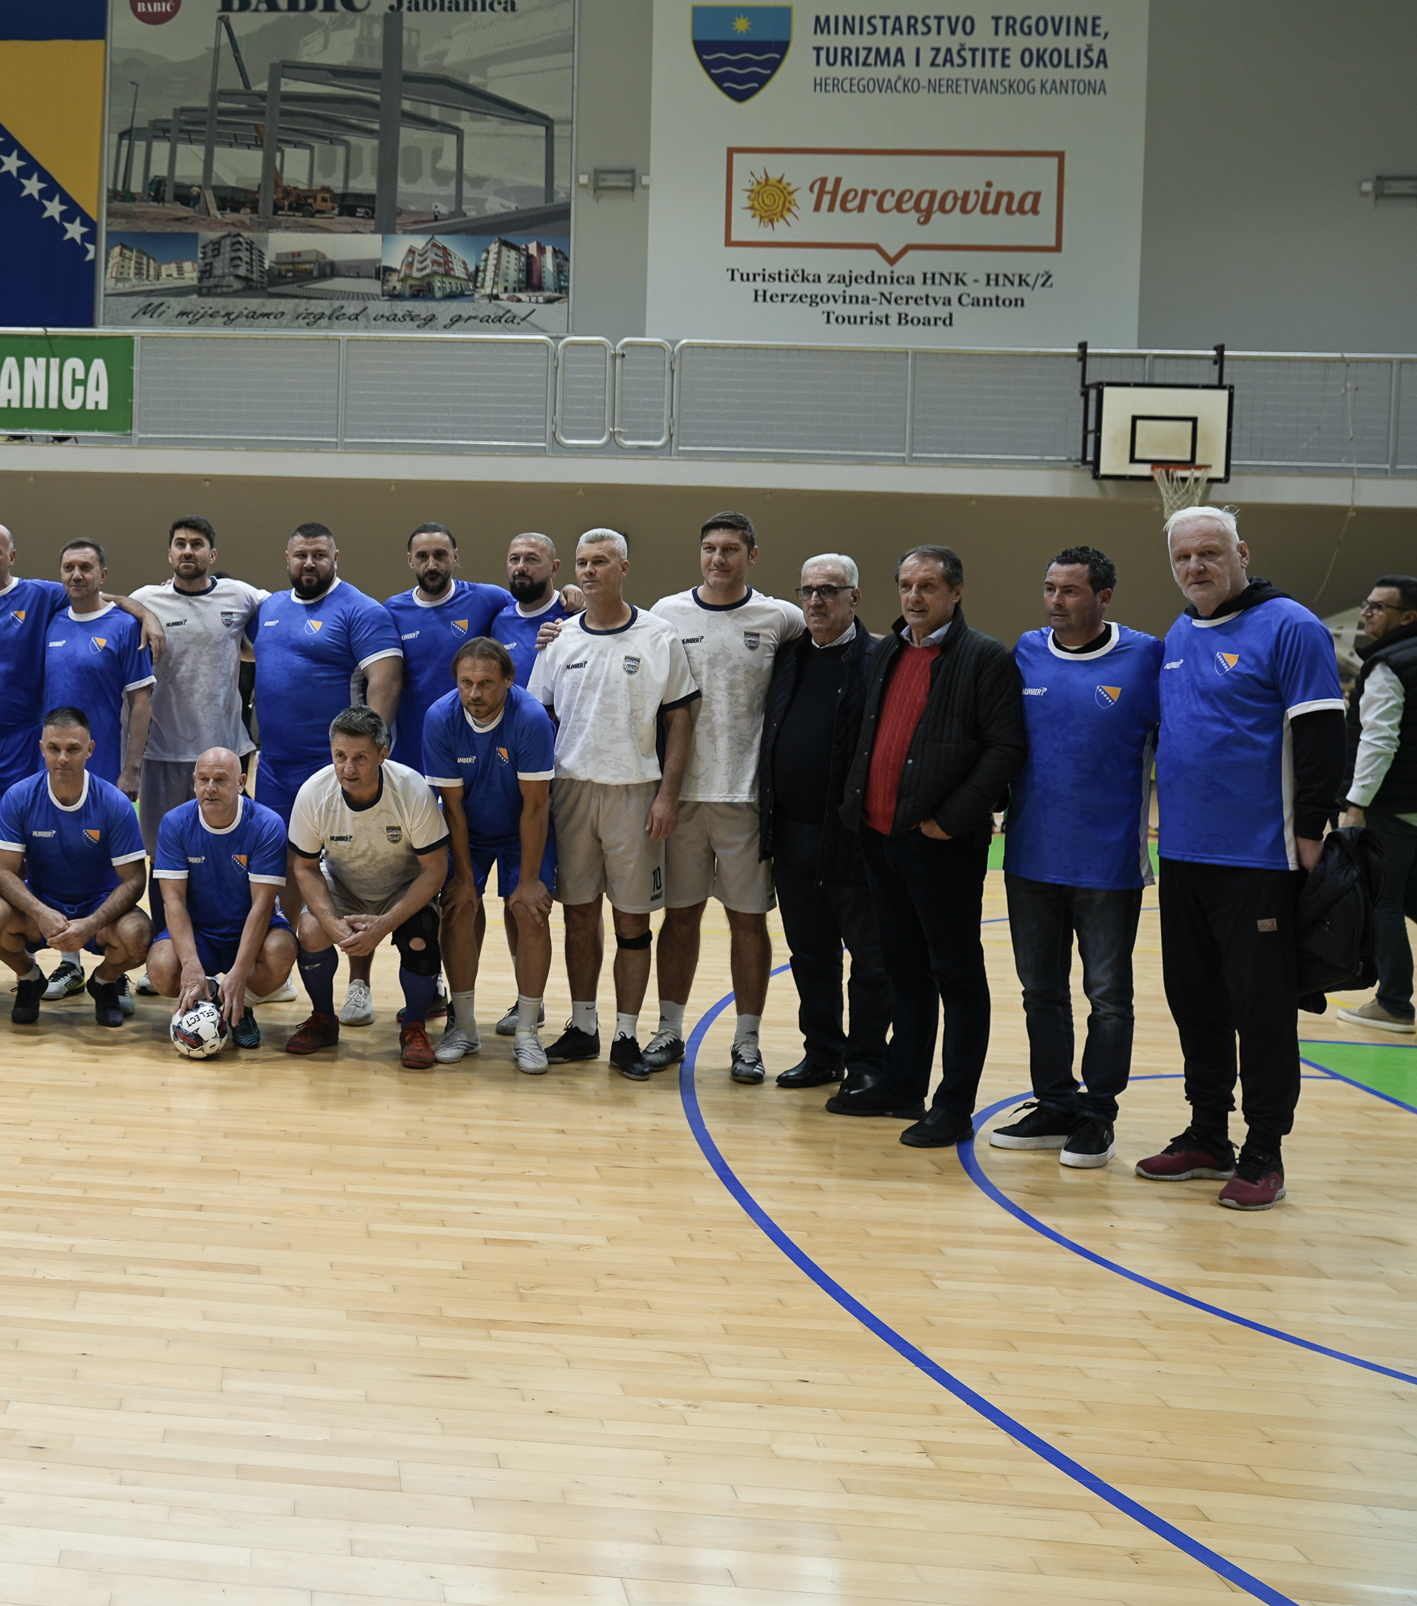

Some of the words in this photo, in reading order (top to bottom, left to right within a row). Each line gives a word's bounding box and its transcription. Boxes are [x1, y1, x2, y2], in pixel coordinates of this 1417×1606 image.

[812, 15, 976, 37] MINISTARSTVO
[991, 16, 1110, 41] TRGOVINE,
[812, 46, 906, 68] TURIZMA
[914, 47, 921, 68] I
[930, 43, 1012, 69] ZAŠTITE
[1020, 43, 1109, 69] OKOLIŠA
[812, 74, 1036, 96] HERCEGOVAČKO-NERETVANSKOG
[1040, 79, 1108, 96] KANTONA
[808, 174, 1042, 226] Hercegovina
[726, 268, 821, 285] Turistička
[827, 270, 916, 290] zajednica
[921, 272, 968, 287] HNK
[985, 270, 1054, 292] HNK/Ž
[752, 289, 952, 307] Herzegovina-Neretva
[957, 292, 1025, 308] Canton
[131, 302, 167, 320] Mi
[176, 304, 286, 326] mijenjamo
[295, 307, 365, 326] izgled
[373, 309, 436, 328] vašeg
[446, 308, 527, 329] grada!
[822, 311, 891, 327] Tourist
[897, 311, 954, 328] Board
[652, 866, 662, 892] 10
[186, 1009, 216, 1028] SELECT
